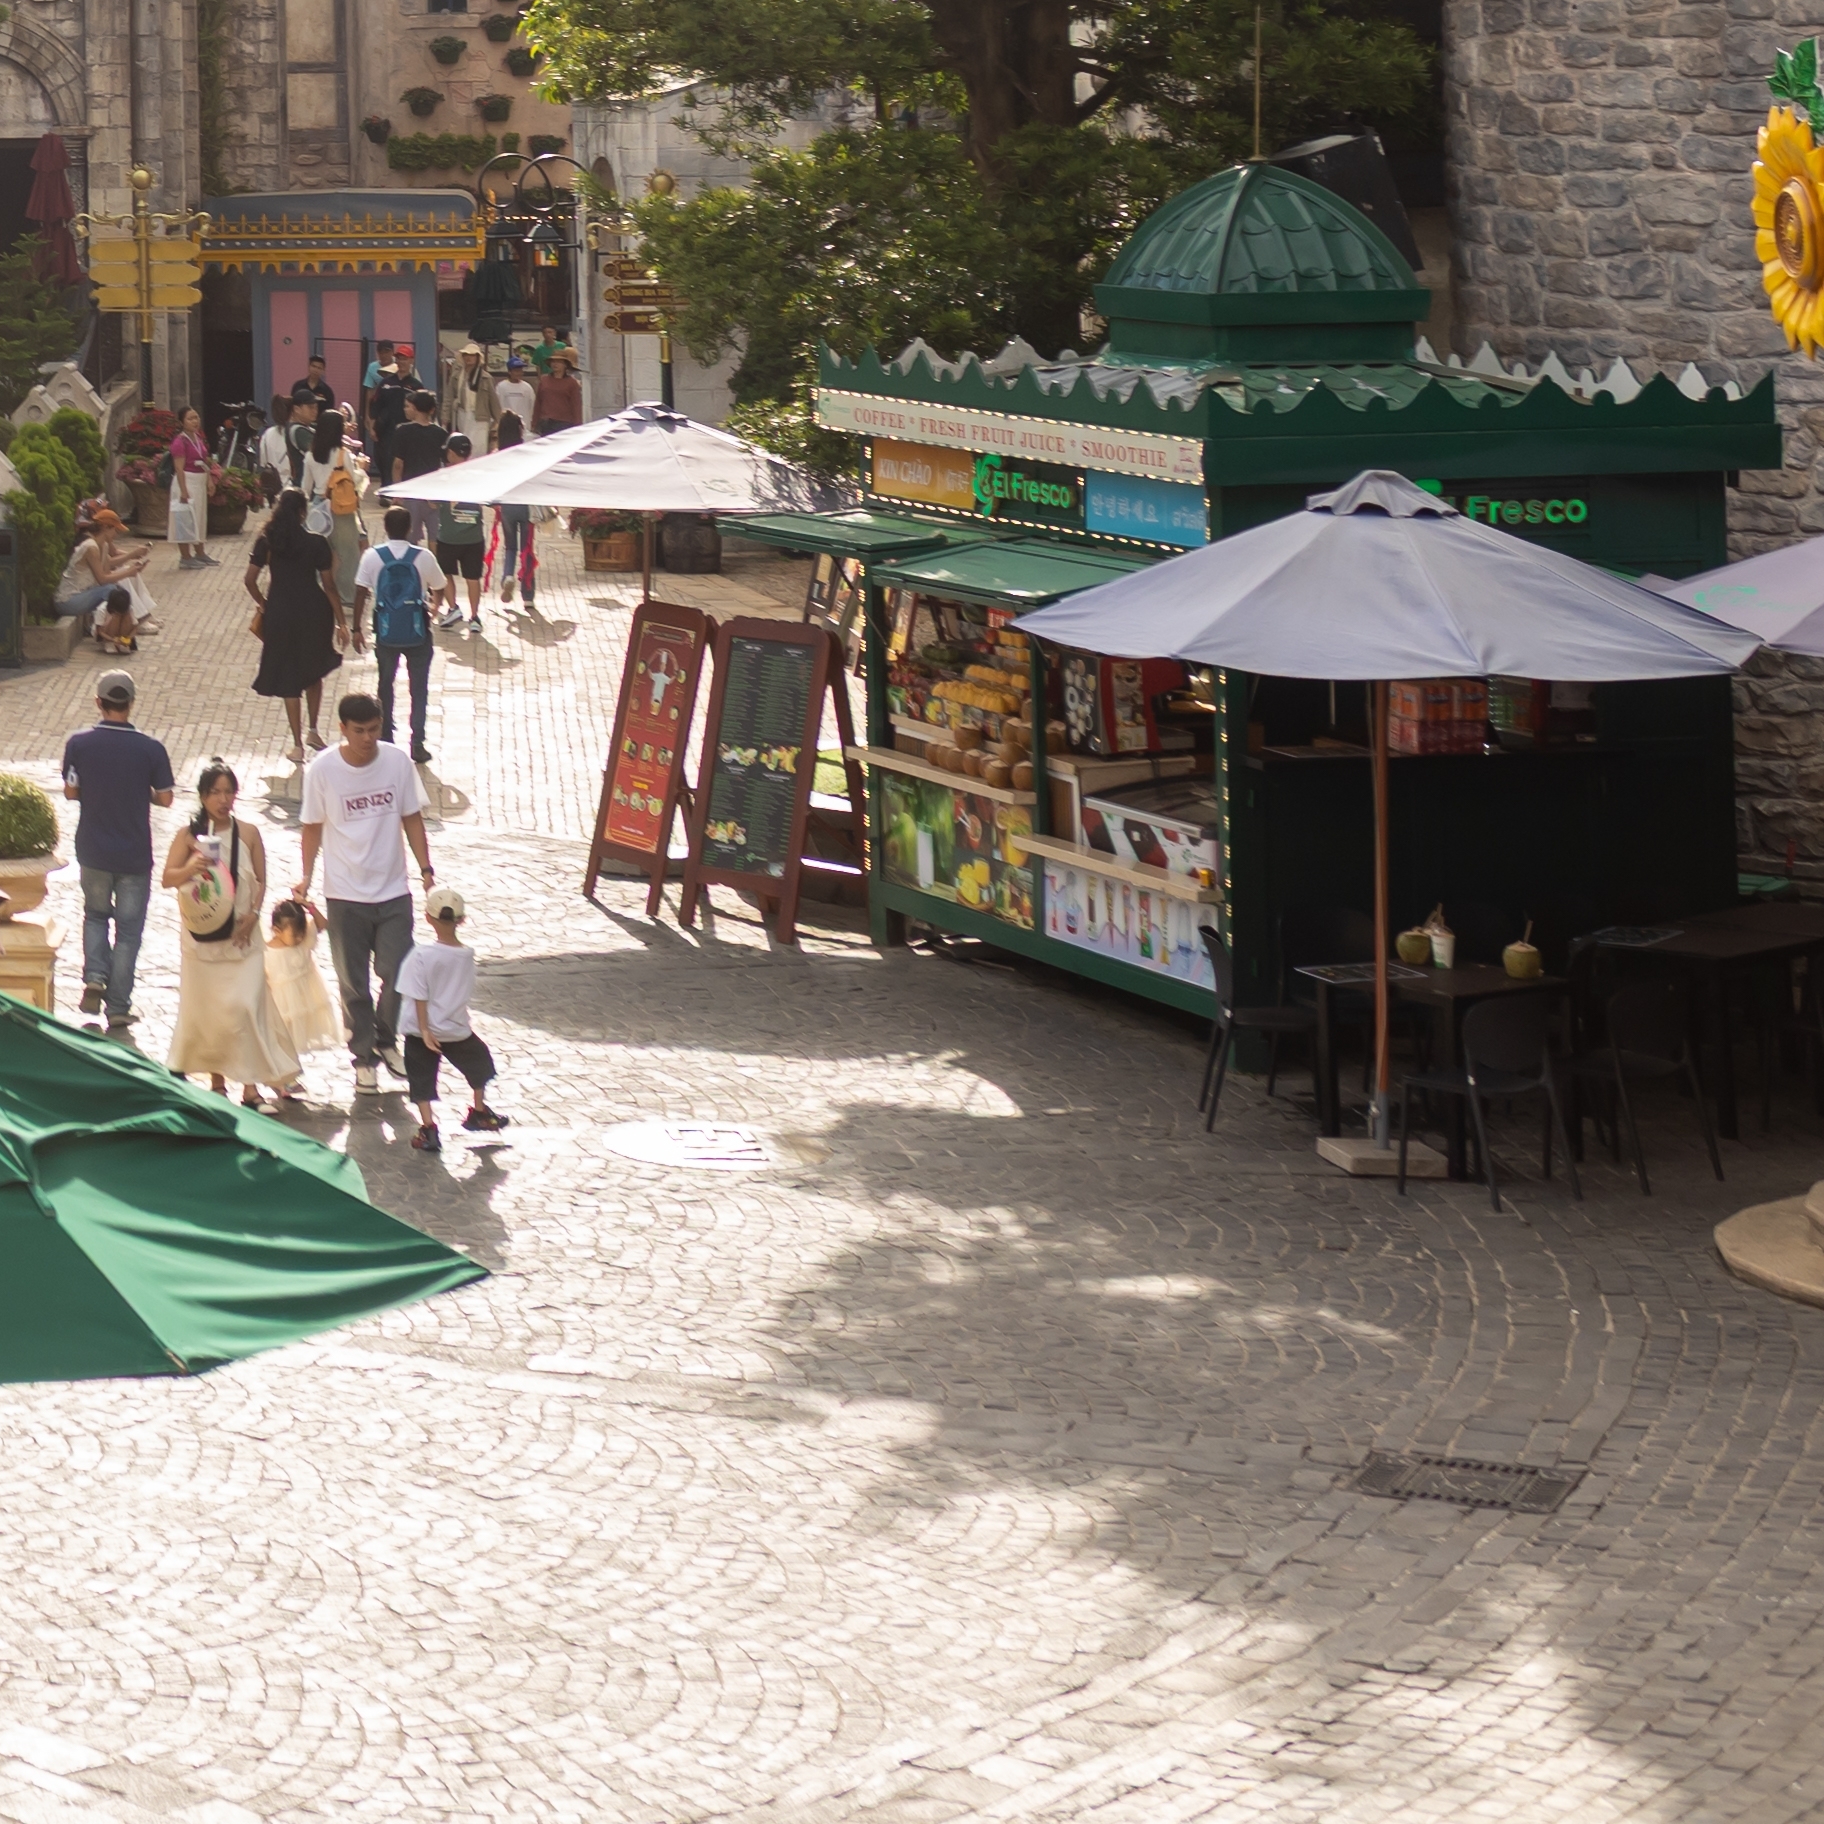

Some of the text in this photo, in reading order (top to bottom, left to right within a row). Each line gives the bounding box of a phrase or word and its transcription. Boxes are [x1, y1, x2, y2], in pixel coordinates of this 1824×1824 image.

[854, 407, 906, 430] COFFEE
[920, 416, 966, 439] FRESH
[971, 425, 1016, 447] FRUIT
[1020, 431, 1066, 453] JUICE
[1081, 440, 1168, 468] SMOOTHIE
[1012, 472, 1070, 509] Fresco
[1466, 495, 1589, 524] Fresco
[346, 791, 394, 811] KENZO
